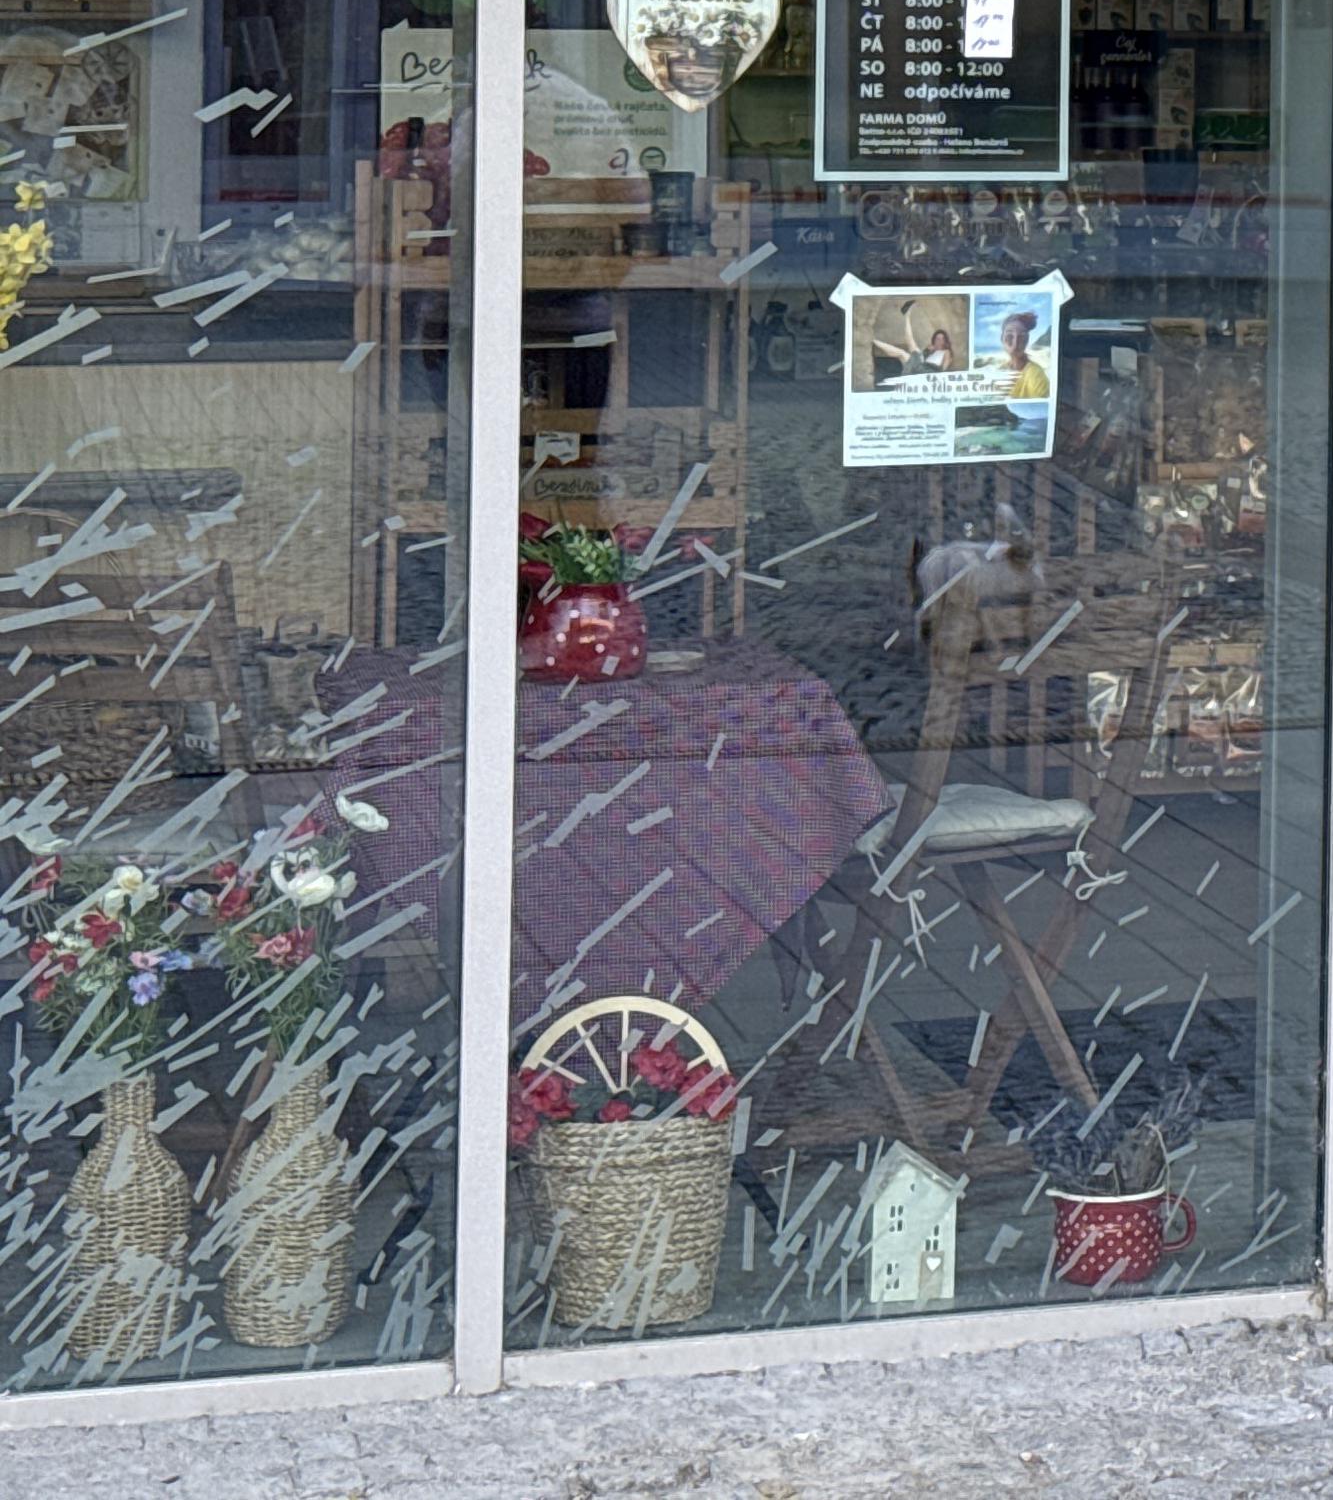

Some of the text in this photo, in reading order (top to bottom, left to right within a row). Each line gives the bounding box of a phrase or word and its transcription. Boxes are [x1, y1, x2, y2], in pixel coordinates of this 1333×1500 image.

[860, 12, 884, 30] ČT
[905, 15, 943, 30] 8:00
[860, 35, 884, 53] PÁ
[905, 38, 943, 53] 8:00
[860, 61, 885, 75] SO
[904, 61, 942, 76] 8:00
[957, 62, 1004, 77] 12:00
[860, 82, 1011, 102] NE odpočíváme
[859, 111, 947, 125] FARMA DOMŮ
